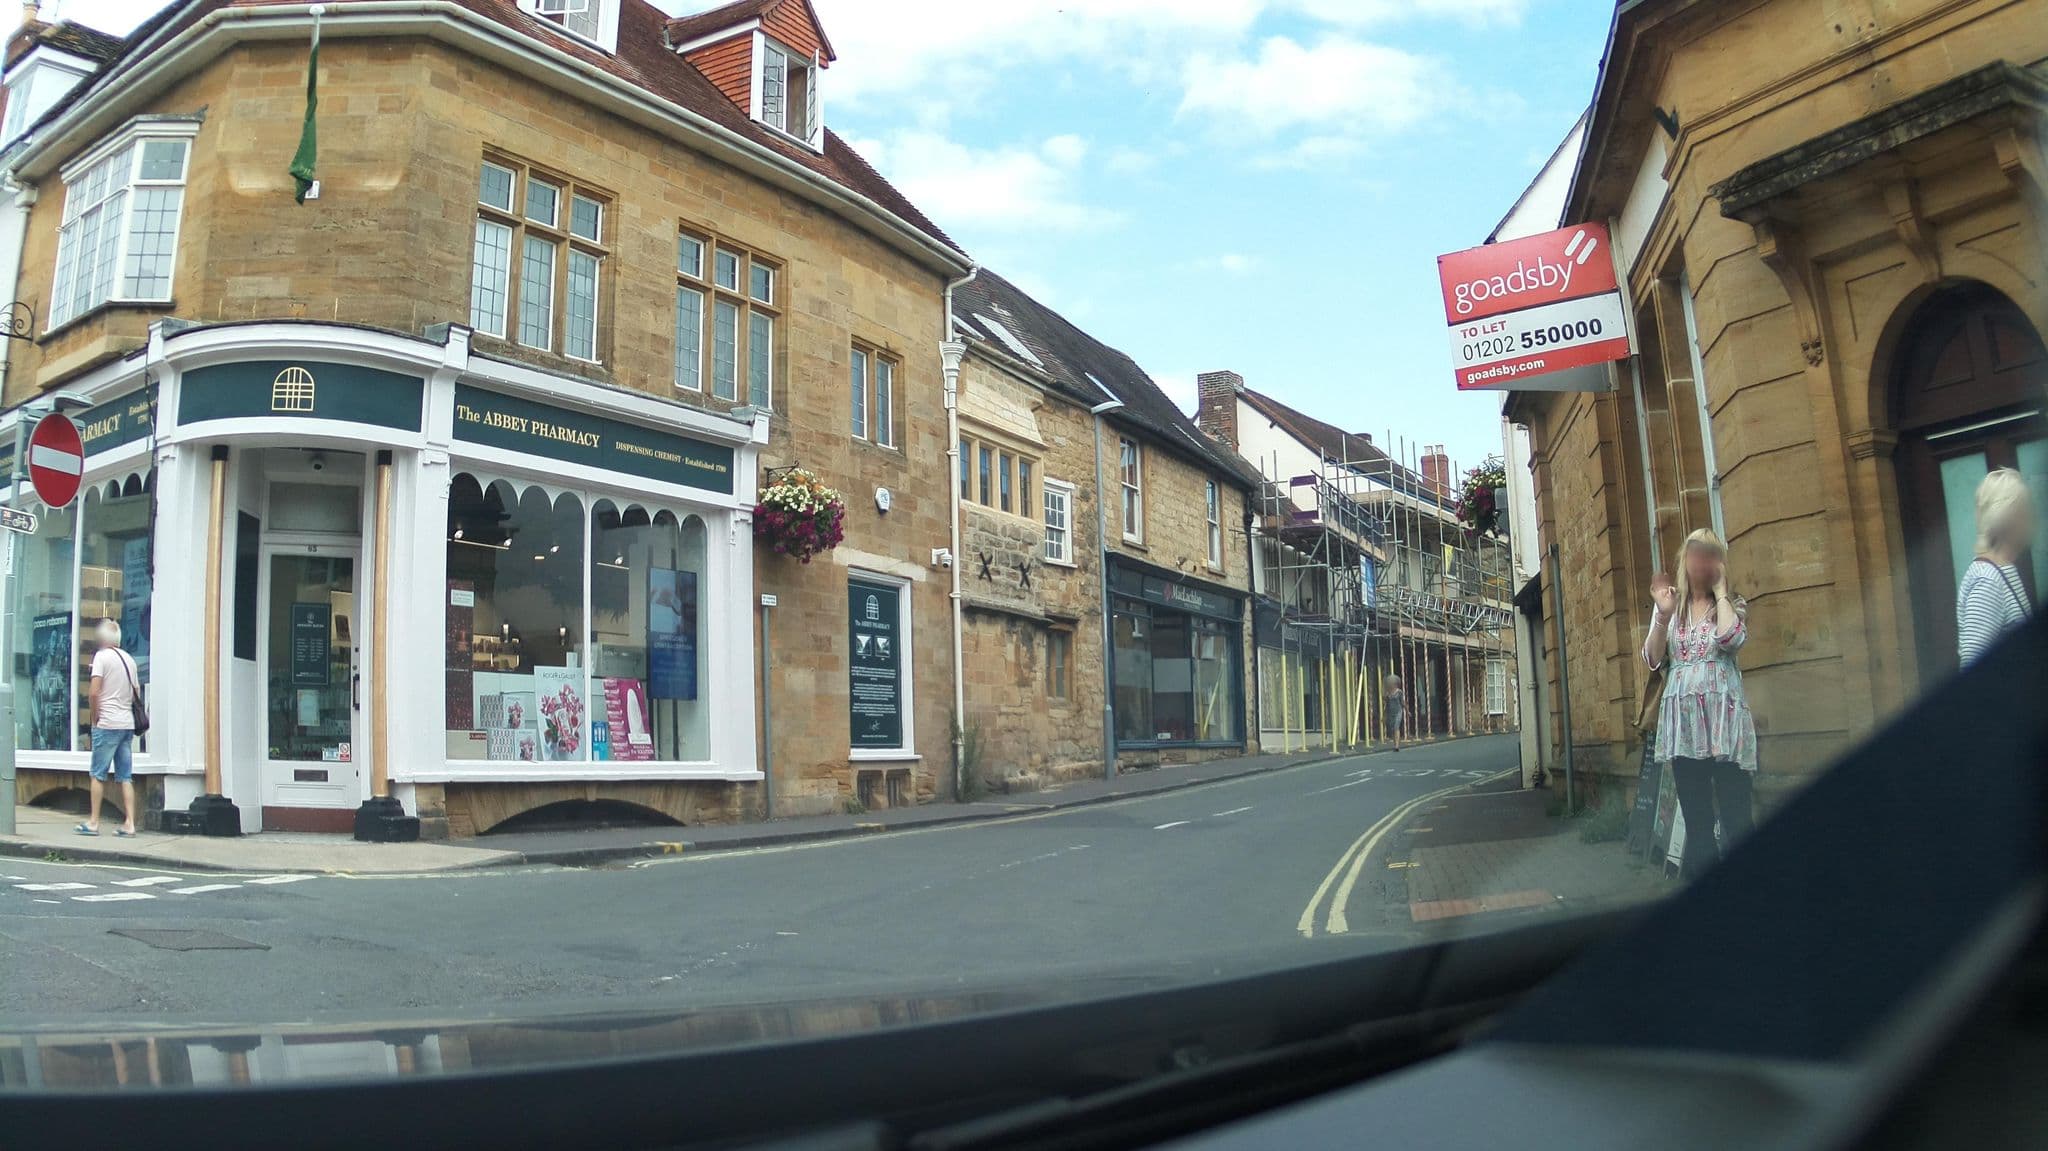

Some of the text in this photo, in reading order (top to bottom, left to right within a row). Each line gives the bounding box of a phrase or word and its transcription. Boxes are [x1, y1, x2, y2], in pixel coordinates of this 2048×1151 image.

[1454, 256, 1573, 314] goadsby
[1461, 320, 1507, 339] TO LET
[1463, 318, 1603, 361] 01202 550000
[1467, 358, 1545, 383] goadsby.com
[457, 404, 600, 448] The ABBEY PHARMACY
[615, 441, 654, 457] DISPENSING
[654, 450, 681, 463] CHEMIST
